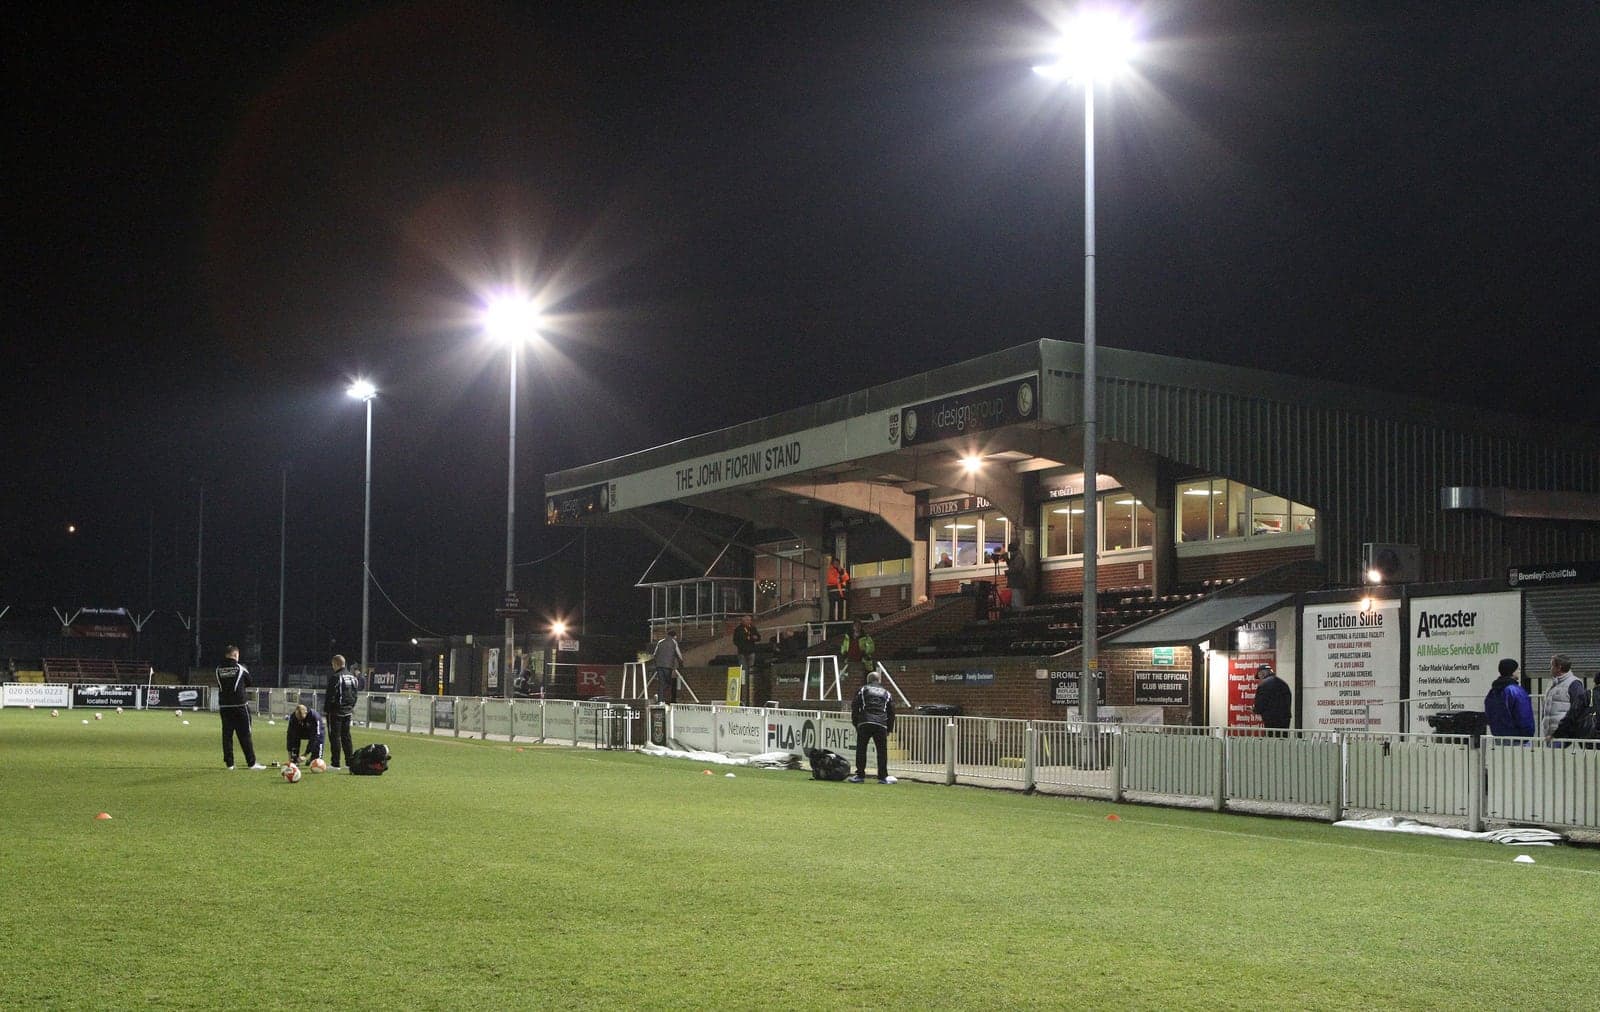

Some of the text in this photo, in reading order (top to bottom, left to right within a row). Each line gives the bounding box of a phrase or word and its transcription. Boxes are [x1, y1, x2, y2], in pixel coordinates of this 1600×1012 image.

[676, 442, 800, 491] THE JOHN FIORINI STAND
[1317, 611, 1382, 628] Function Suite
[1417, 610, 1477, 638] Ancaster
[1417, 642, 1499, 656] All Makes Service & MOT
[728, 722, 760, 737] Networkers
[768, 724, 795, 748] FILA
[804, 728, 814, 749] JD
[826, 728, 849, 749] PAYE
